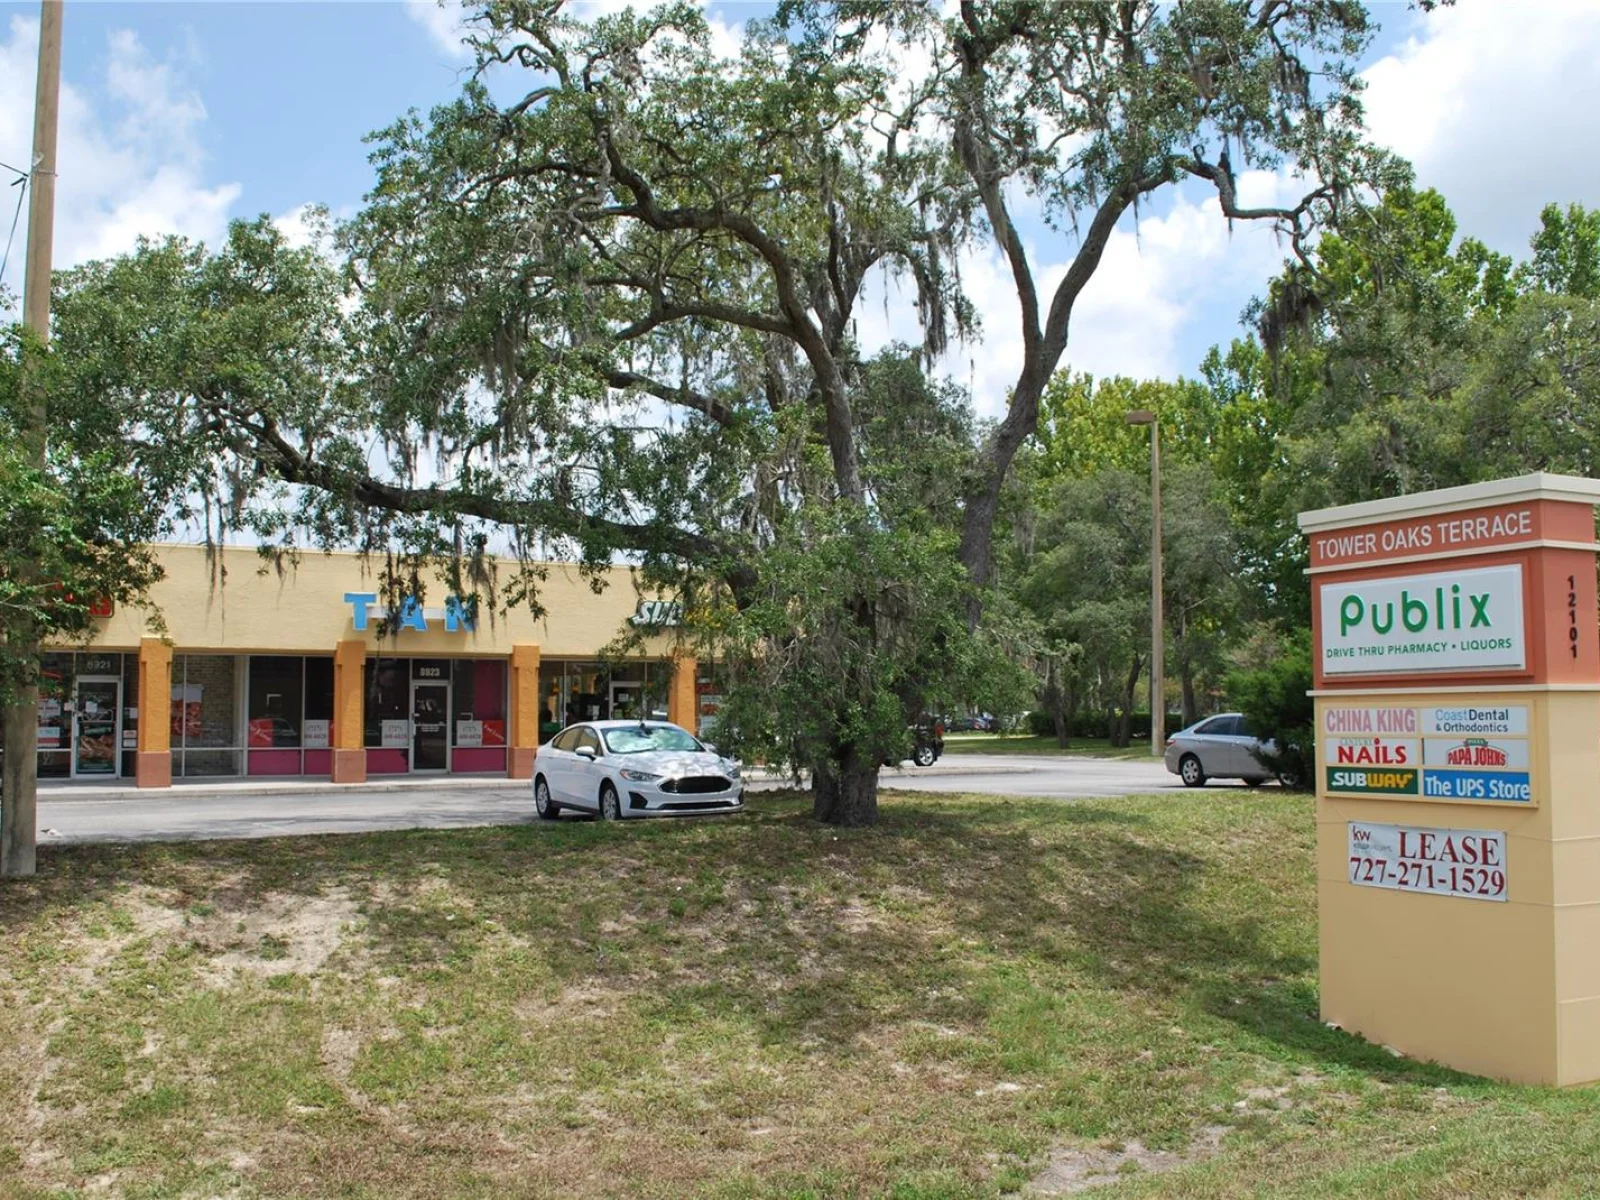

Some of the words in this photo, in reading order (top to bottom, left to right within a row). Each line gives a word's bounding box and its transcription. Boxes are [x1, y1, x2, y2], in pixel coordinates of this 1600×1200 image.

[1317, 533, 1377, 560] TOWER
[1382, 525, 1433, 551] OAKS
[1437, 511, 1532, 544] TERRACE
[1340, 584, 1492, 637] Publix
[1567, 575, 1578, 659] 12101
[1326, 647, 1355, 658] DRIVE
[1358, 645, 1385, 656] THRU
[1387, 642, 1448, 655] PHARMACY
[1460, 638, 1512, 651] LIQUORS
[1326, 709, 1372, 732] CHINA
[1377, 709, 1415, 732] KING
[1443, 722, 1509, 732] Orthodontics
[1447, 747, 1473, 766] PAPA
[1331, 772, 1413, 788] SUBWAY
[1425, 775, 1452, 796] The
[1456, 778, 1485, 797] UPS
[1489, 780, 1530, 800] Store
[1352, 825, 1371, 841] kw
[1399, 831, 1501, 867] LEASE
[1350, 856, 1506, 897] 727-271-1529
